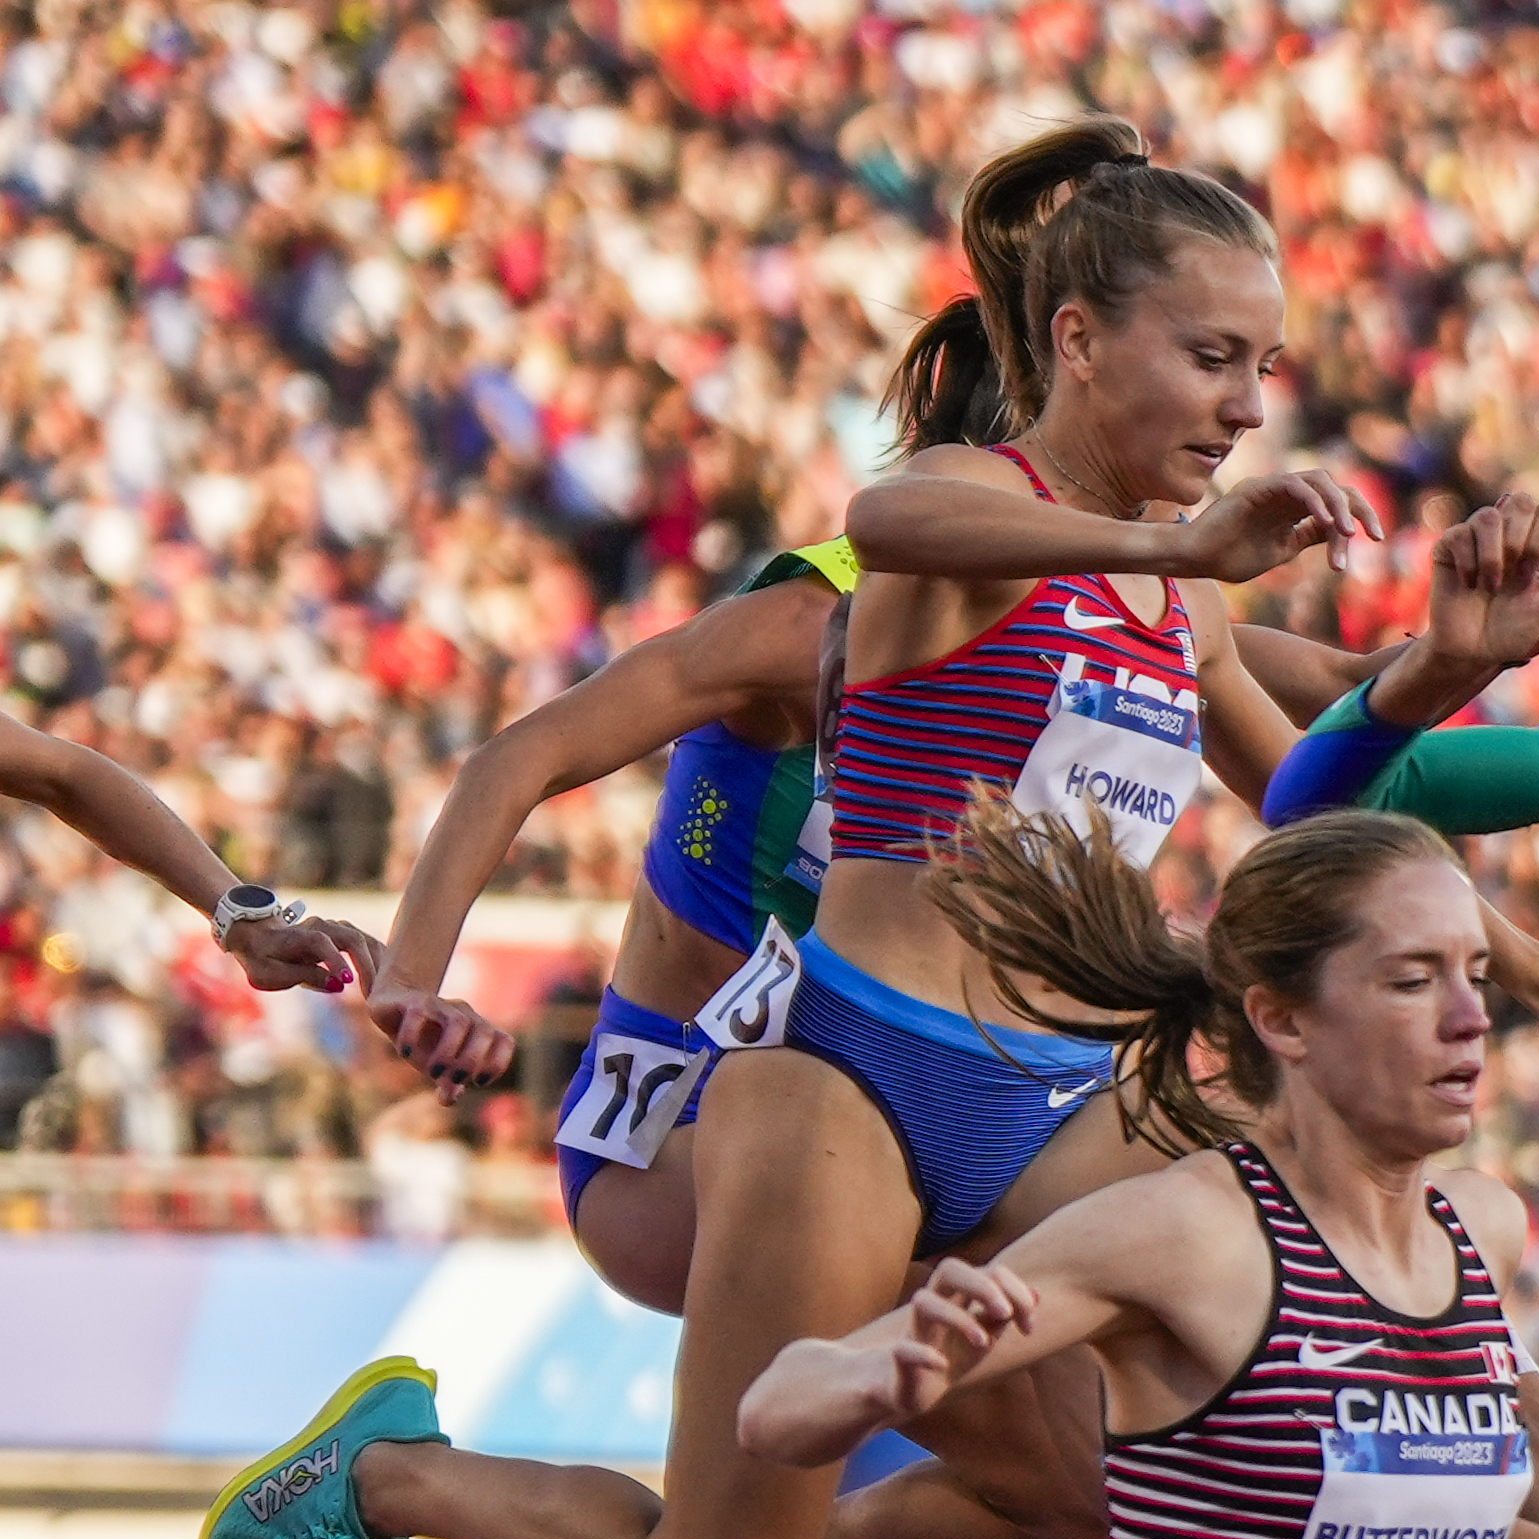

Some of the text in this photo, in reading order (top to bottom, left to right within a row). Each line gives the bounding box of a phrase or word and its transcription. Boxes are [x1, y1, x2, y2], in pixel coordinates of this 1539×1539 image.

[1065, 762, 1176, 826] HOWARD
[714, 939, 796, 1044] 13
[1335, 1387, 1521, 1435] CANADA
[242, 1438, 340, 1523] HOKA
